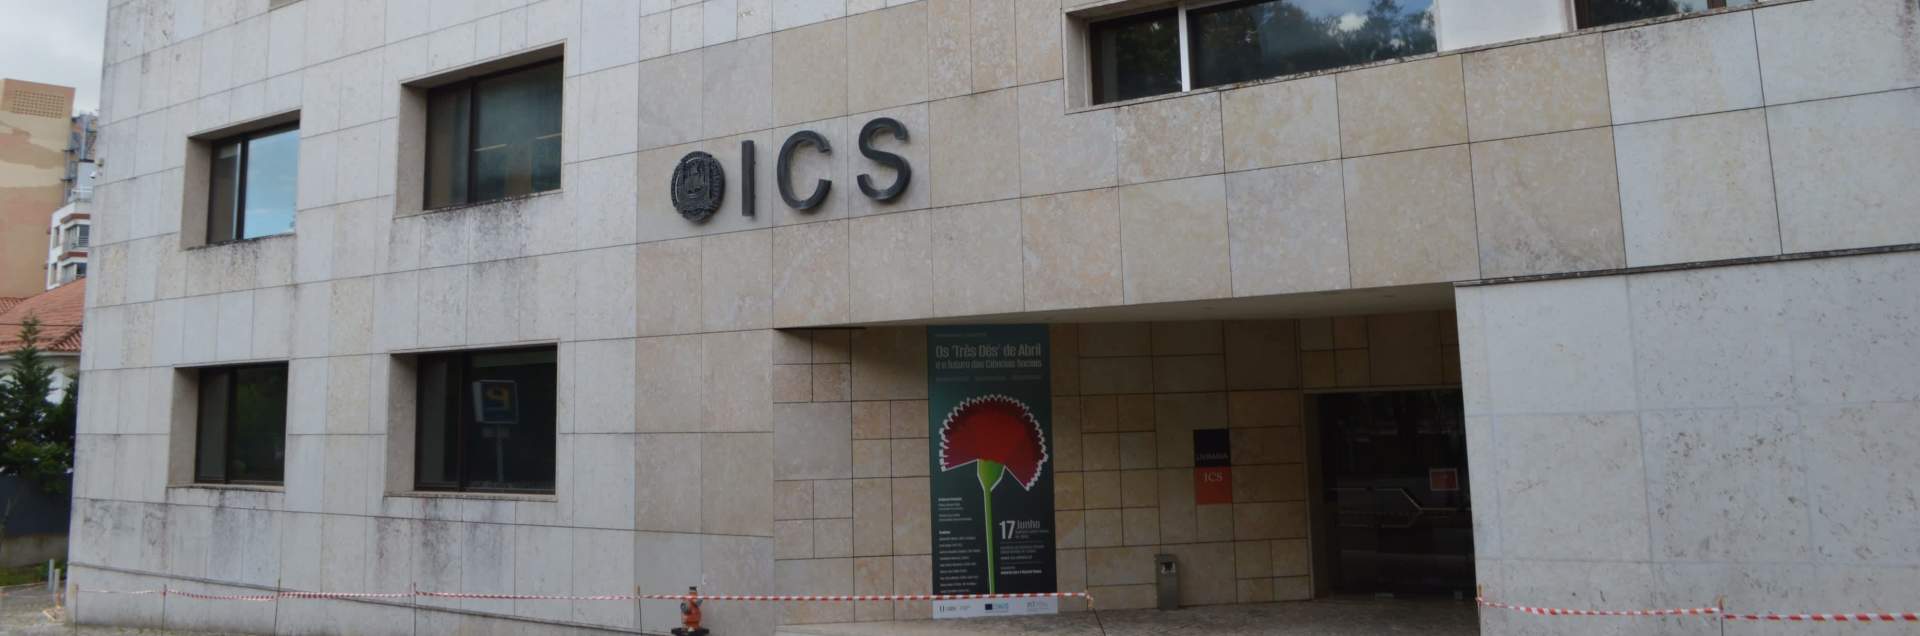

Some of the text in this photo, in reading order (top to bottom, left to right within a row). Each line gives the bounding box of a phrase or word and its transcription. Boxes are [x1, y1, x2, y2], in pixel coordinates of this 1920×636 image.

[741, 117, 912, 218] ICS
[936, 344, 949, 358] Os
[1003, 343, 1016, 357] de
[1017, 343, 1041, 357] Abril
[1203, 471, 1224, 482] ICS
[999, 520, 1015, 539] 17
